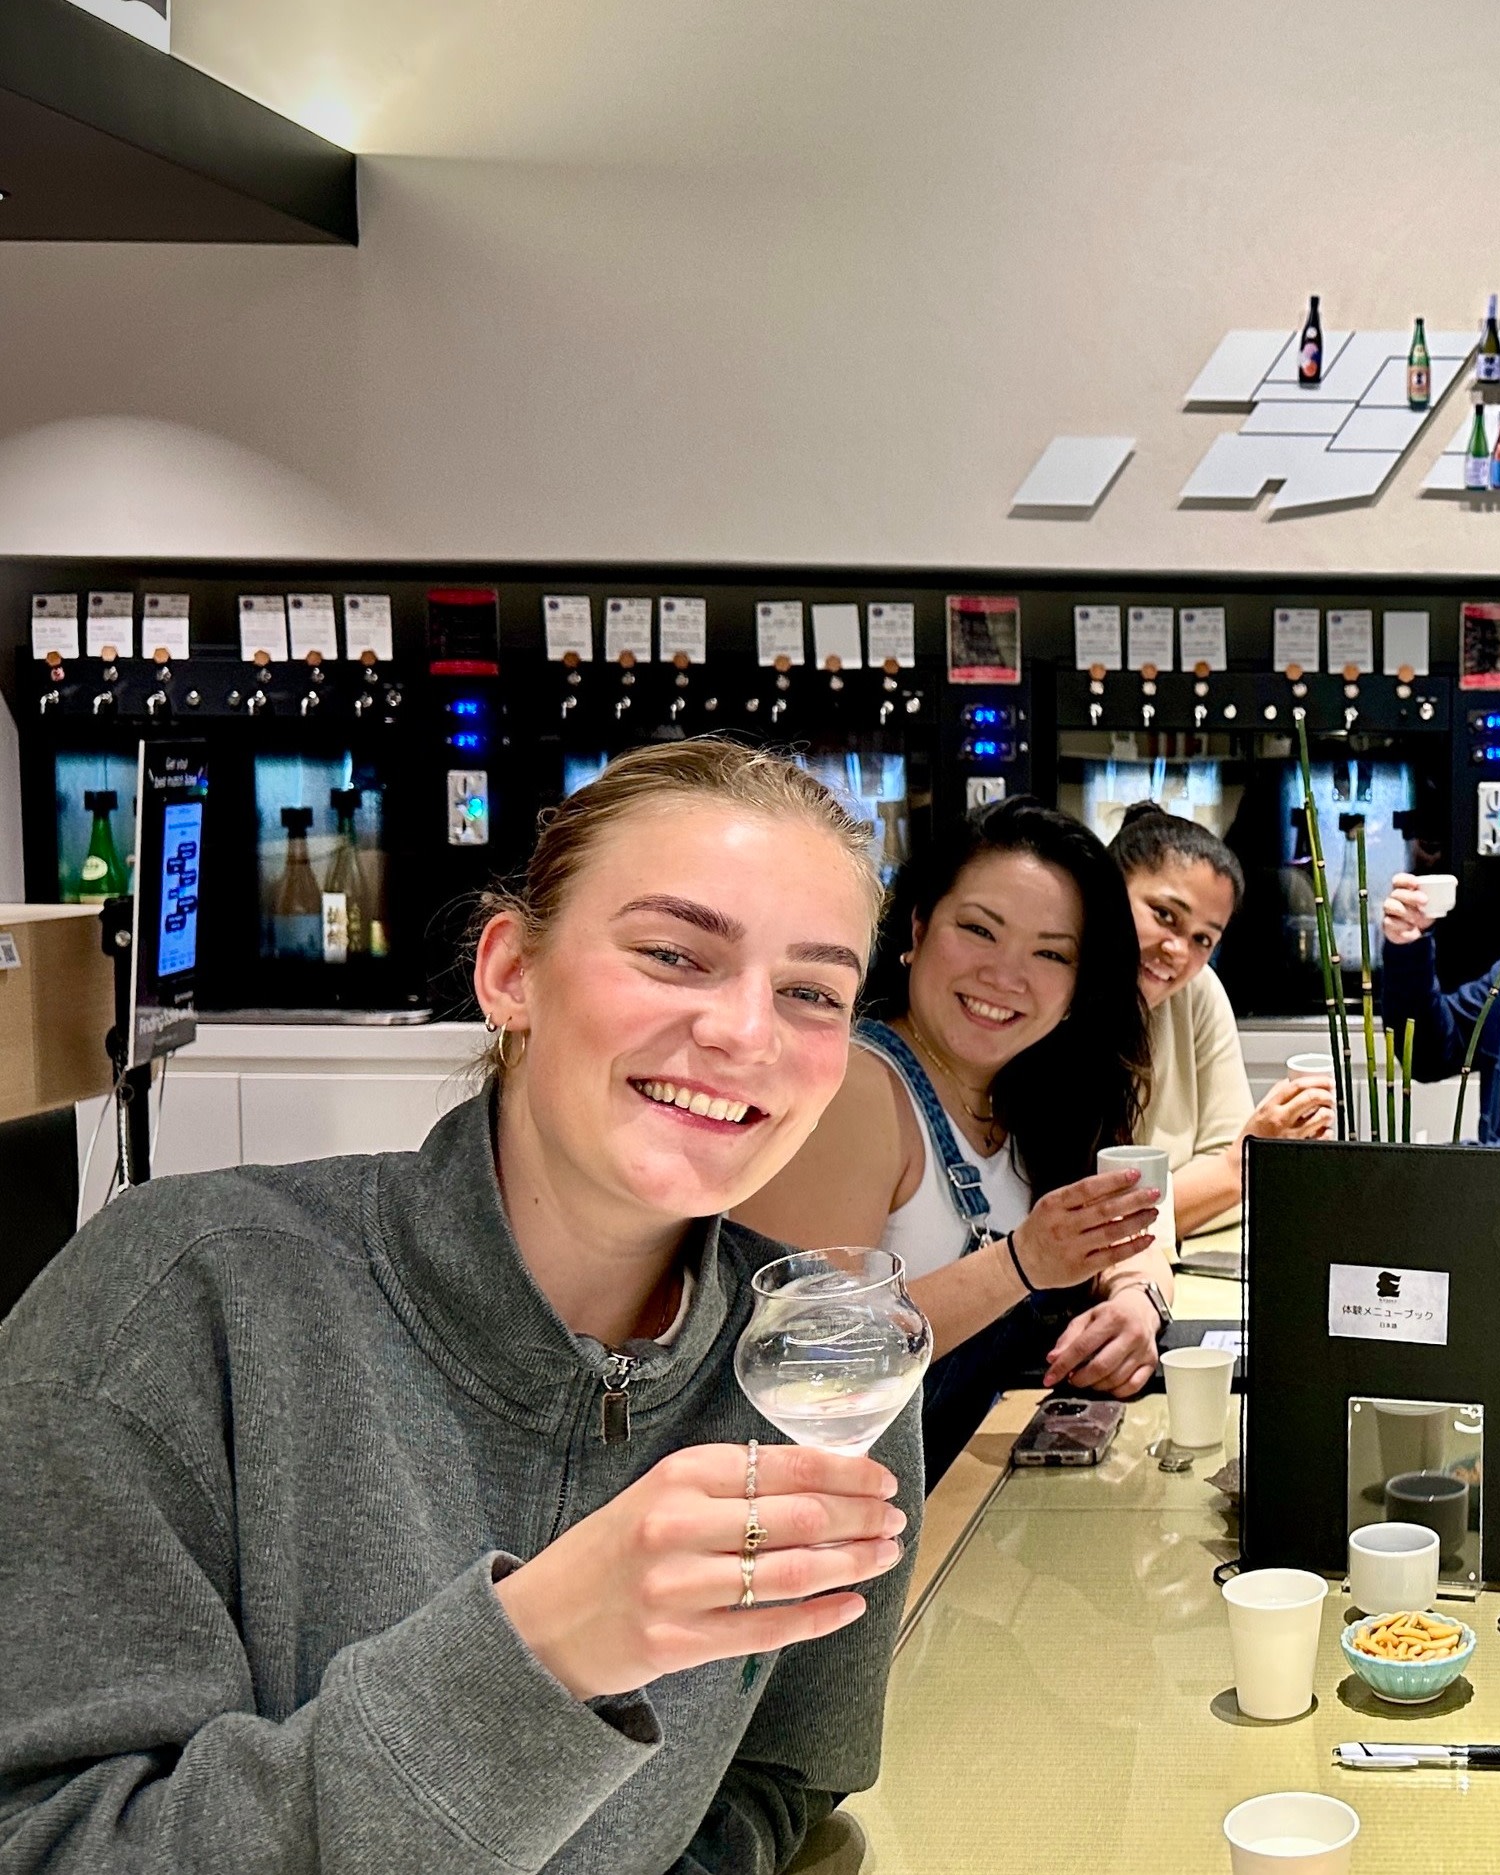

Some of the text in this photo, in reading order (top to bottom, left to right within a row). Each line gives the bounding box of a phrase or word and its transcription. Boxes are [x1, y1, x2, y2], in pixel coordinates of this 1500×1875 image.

[1342, 1304, 1434, 1321] 体験メニューブック
